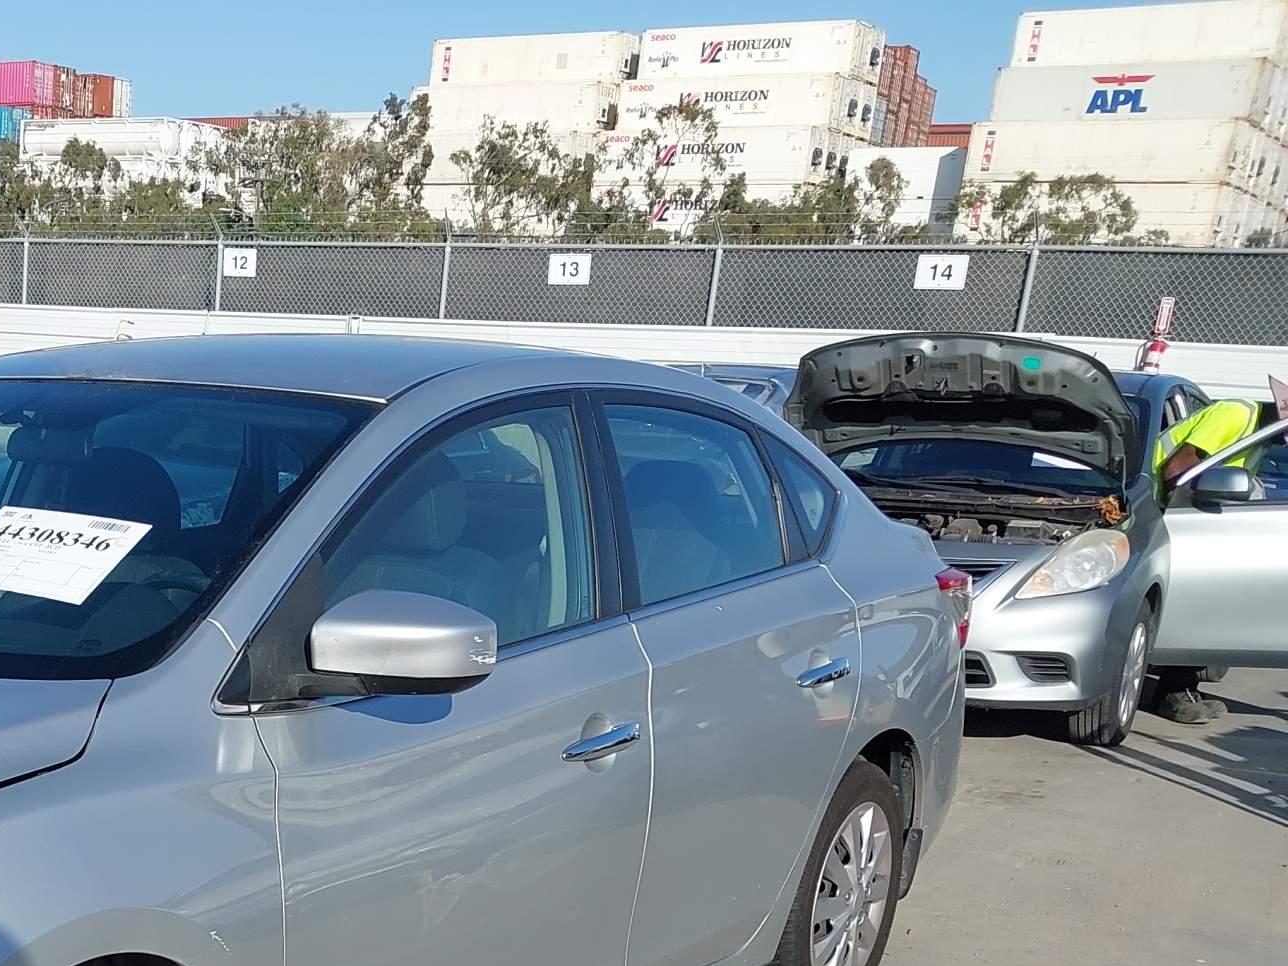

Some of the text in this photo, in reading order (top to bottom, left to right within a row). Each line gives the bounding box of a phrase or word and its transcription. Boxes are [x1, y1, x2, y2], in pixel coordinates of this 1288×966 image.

[651, 34, 677, 42] seaco
[726, 37, 792, 51] HORIZON
[724, 50, 780, 59] LINES
[704, 89, 770, 102] HORIZON
[1085, 88, 1148, 114] APL
[606, 135, 631, 143] seaco
[680, 142, 747, 155] HORIZON
[232, 255, 248, 270] 12
[560, 261, 579, 277] 13
[930, 263, 953, 281] 14
